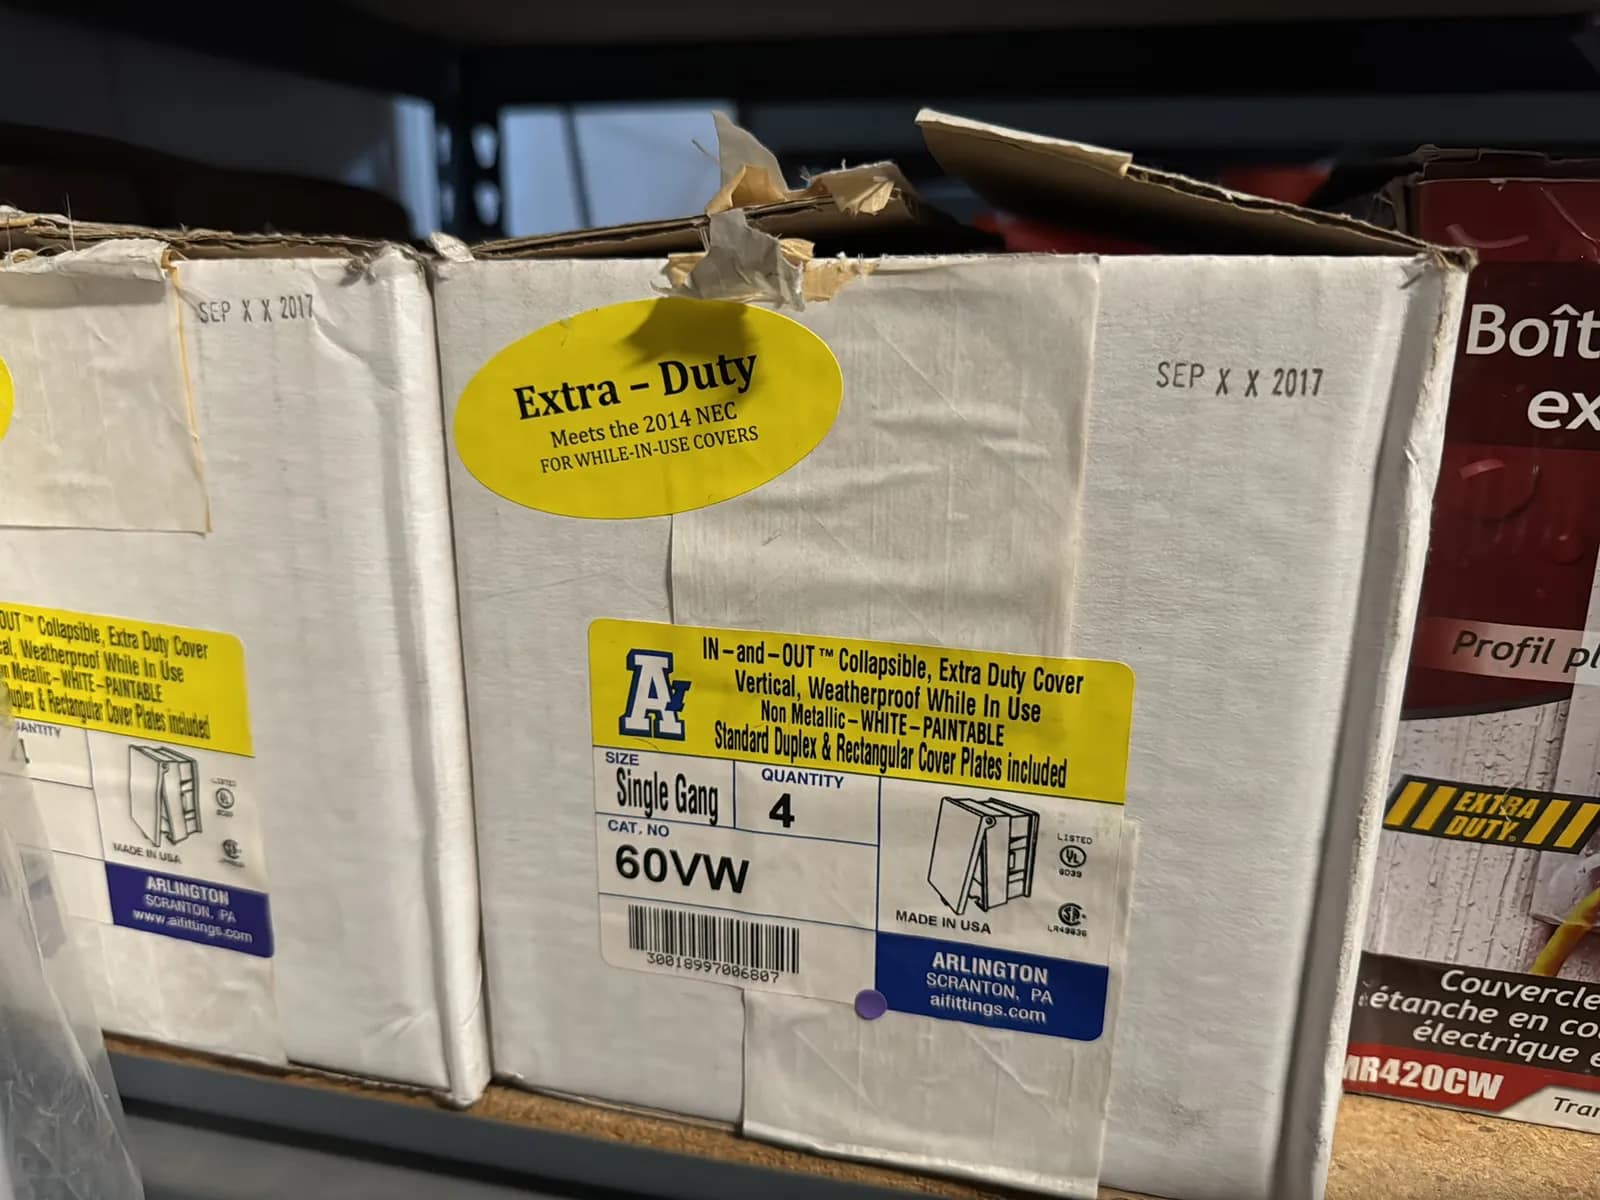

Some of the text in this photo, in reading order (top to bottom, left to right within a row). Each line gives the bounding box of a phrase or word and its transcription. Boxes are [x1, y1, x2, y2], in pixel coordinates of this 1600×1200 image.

[198, 294, 312, 323] SEP X X 2017
[1465, 303, 1600, 359] Boît
[513, 376, 621, 420] Extra
[658, 352, 758, 396] Duty
[1156, 361, 1323, 397] SEP X X 2017
[550, 401, 737, 449] Meets the 2014 NEC
[540, 425, 759, 474] FOR WHILE-IN-USE COVERS
[38, 615, 105, 648] Collapsible,
[108, 626, 139, 649] Extra
[142, 630, 168, 658] Duty
[174, 635, 208, 659] Cover
[1452, 630, 1556, 668] Profil
[20, 639, 100, 670] Weatherproof
[103, 651, 139, 676] While
[144, 657, 156, 678] In
[160, 660, 184, 682] Use
[839, 647, 932, 683] Collapsible,
[939, 657, 981, 685] Extra
[988, 662, 1026, 694] Duty
[1033, 666, 1084, 694] Cover
[47, 688, 104, 724] Rectangular
[106, 699, 133, 726] Cover
[135, 703, 166, 732] Plates
[735, 669, 1041, 722] Vertical, Weatherproof While In Use
[761, 700, 786, 723] Non
[605, 751, 640, 766] SIZE
[715, 720, 1068, 788] Standard Duplex & Rectangular Cover Plates included
[761, 767, 844, 789] QUANTITY
[616, 767, 719, 826] Single Gang
[769, 793, 795, 828] 4
[1453, 791, 1540, 819] EXTRA
[647, 824, 670, 837] NO
[1057, 833, 1093, 845] LISTED
[113, 843, 182, 864] MADE IN USA
[615, 844, 750, 894] 60VW
[146, 876, 229, 905] ARLINGTON
[132, 909, 253, 943] www.aifittings.com
[219, 908, 237, 923] PA
[895, 909, 992, 935] MADE IN USA
[932, 951, 1048, 985] ARLINGTON
[926, 972, 1054, 1006] SCRANTON, PA
[1441, 969, 1600, 1012] Couvercle
[930, 992, 1047, 1024] aifittings.com
[1370, 985, 1499, 1024] étanche
[1508, 1011, 1548, 1032] en
[1413, 1019, 1579, 1063] électrique
